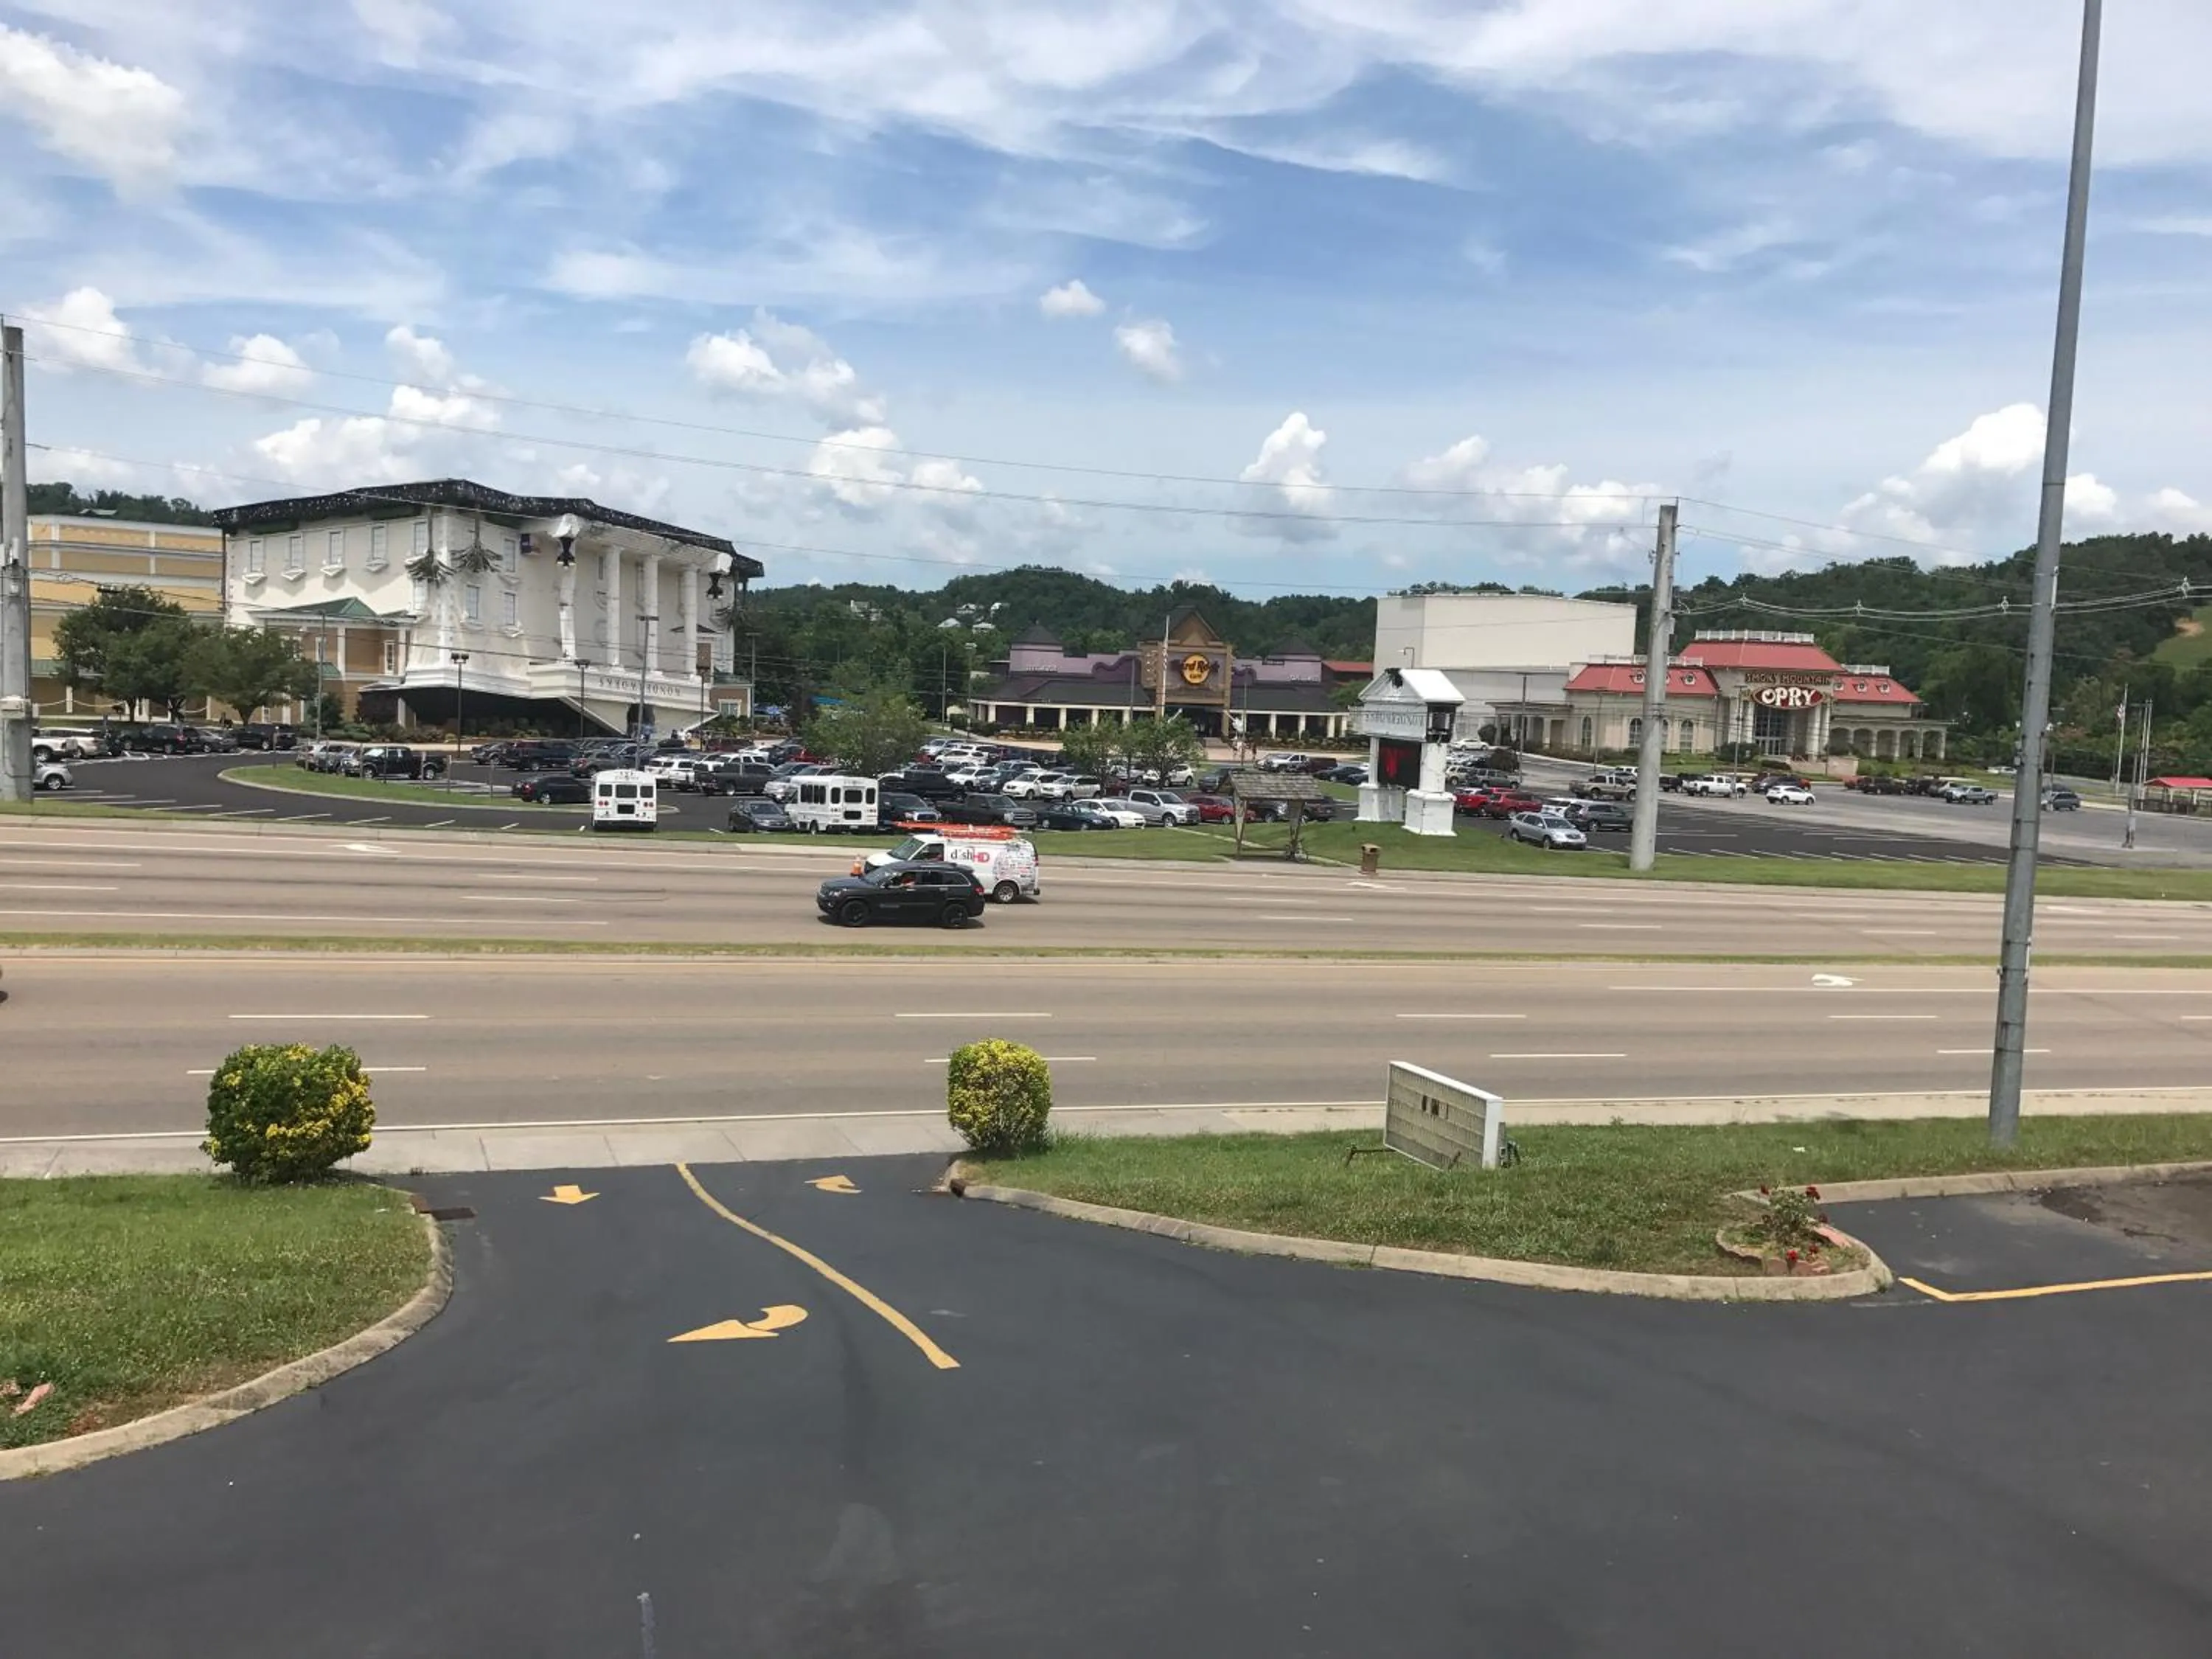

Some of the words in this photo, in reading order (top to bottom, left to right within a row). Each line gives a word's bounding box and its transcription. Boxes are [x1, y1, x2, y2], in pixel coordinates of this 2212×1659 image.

[1745, 672, 1778, 684] SMOKY
[1781, 673, 1832, 686] MOUNTAIN
[1761, 686, 1815, 706] OPRY
